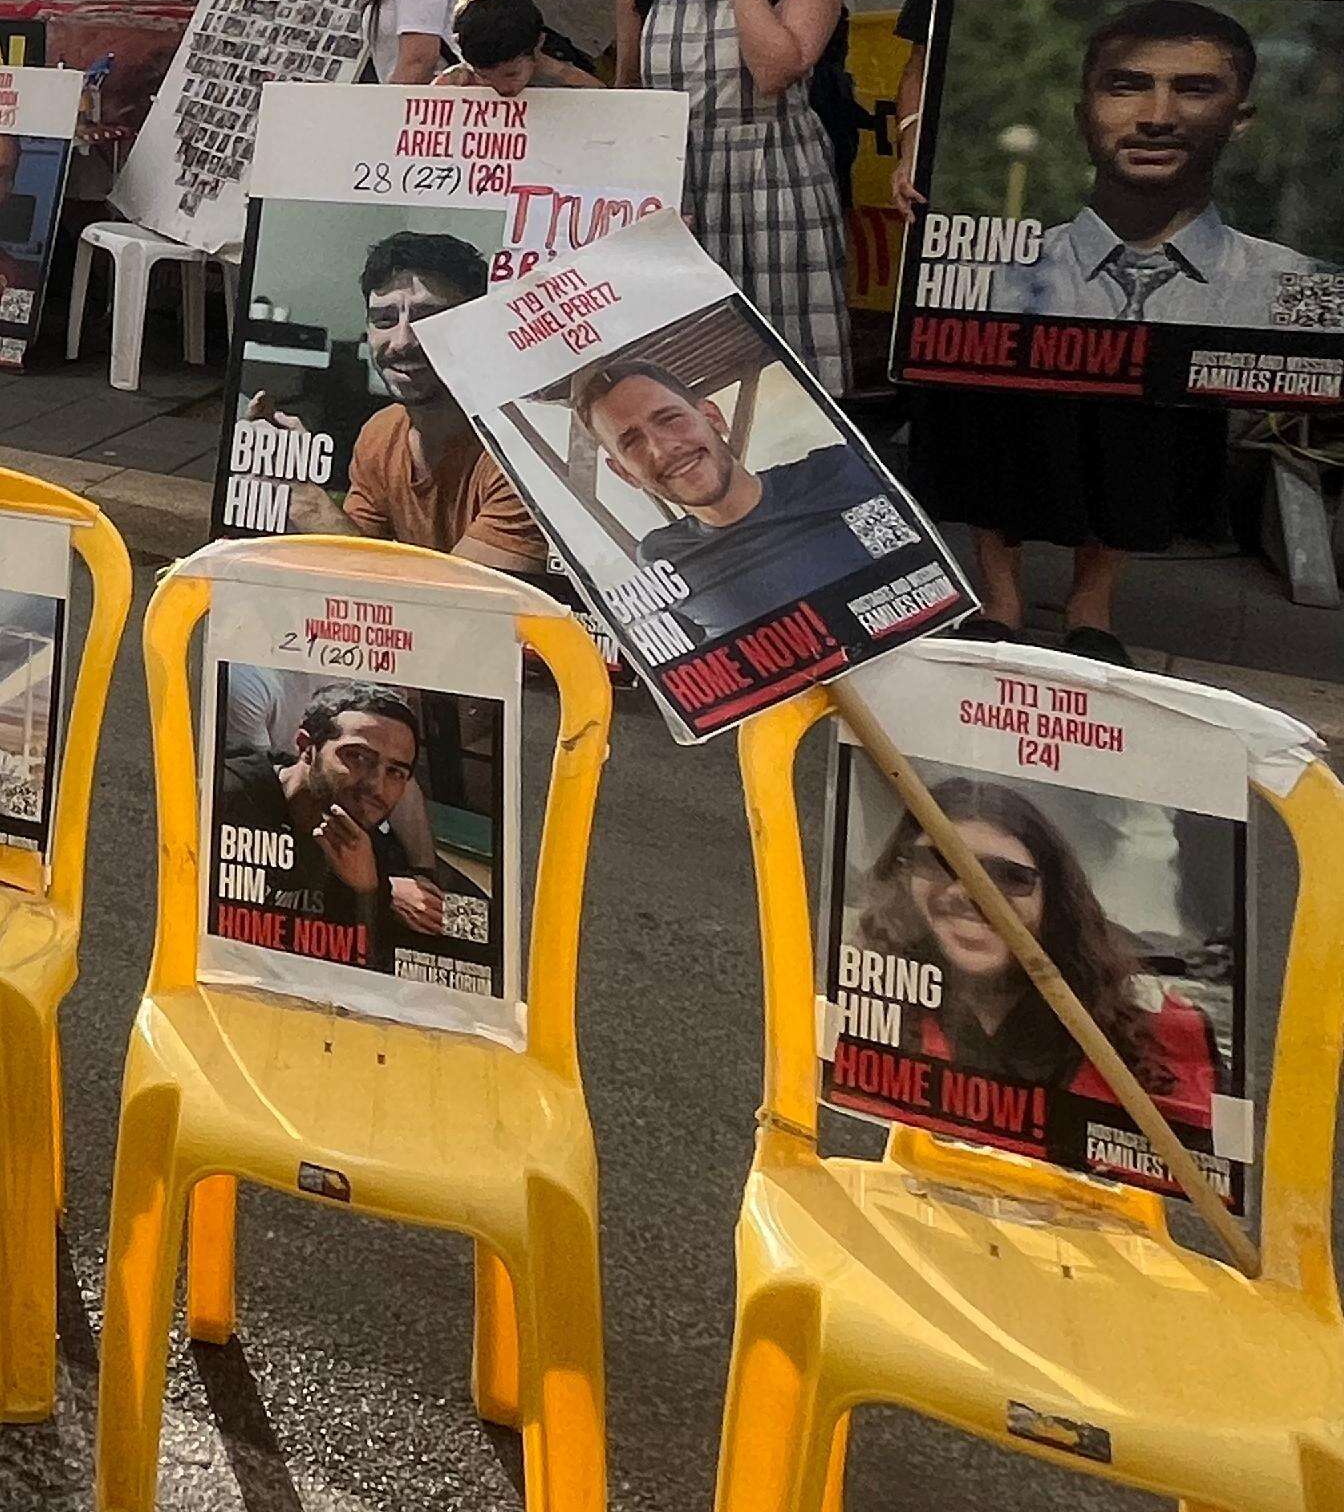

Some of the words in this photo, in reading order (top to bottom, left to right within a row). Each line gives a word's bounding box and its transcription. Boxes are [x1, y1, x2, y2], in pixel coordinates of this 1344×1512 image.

[405, 98, 454, 130] קוניו
[462, 99, 527, 128] אריאל
[396, 130, 453, 158] ARIEL
[462, 132, 528, 160] CUNIO
[353, 162, 391, 194] 28
[922, 213, 1044, 265] BRING
[506, 291, 544, 322] פרץ
[535, 269, 587, 303] דניאל
[916, 263, 994, 312] HIM
[508, 311, 566, 351] DANIEL
[560, 282, 621, 322] PERETZ
[562, 320, 602, 355] (22)
[912, 317, 1019, 367] HOME
[1030, 324, 1149, 377] NOW!
[1188, 365, 1272, 393] FAMILIES
[1273, 371, 1342, 398] FORUM
[231, 419, 334, 484] BRING
[224, 476, 290, 533] HIM
[353, 601, 393, 625] נמרוד
[603, 559, 689, 624] BRING
[858, 594, 923, 636] FAMILIES
[912, 576, 959, 609] FORUM
[305, 618, 360, 644] NIMROD
[366, 626, 412, 651] COHEN
[630, 612, 696, 667] HIM
[663, 647, 754, 713] HOME
[737, 601, 836, 677] NOW!
[1046, 687, 1087, 716] סהר
[960, 699, 1029, 734] SAHAR
[1037, 713, 1124, 752] BARUCH
[1018, 737, 1059, 771] (24)
[220, 824, 294, 870] BRING
[218, 862, 265, 904] HIM
[218, 905, 287, 950] HOME
[293, 917, 369, 966] NOW!
[395, 959, 448, 987] FAMILIES
[839, 945, 942, 1009] BRING
[837, 990, 902, 1048] HIM
[835, 1042, 932, 1108] HOME
[941, 1069, 1047, 1139] NOW!
[1087, 1137, 1163, 1179] FAMILIES
